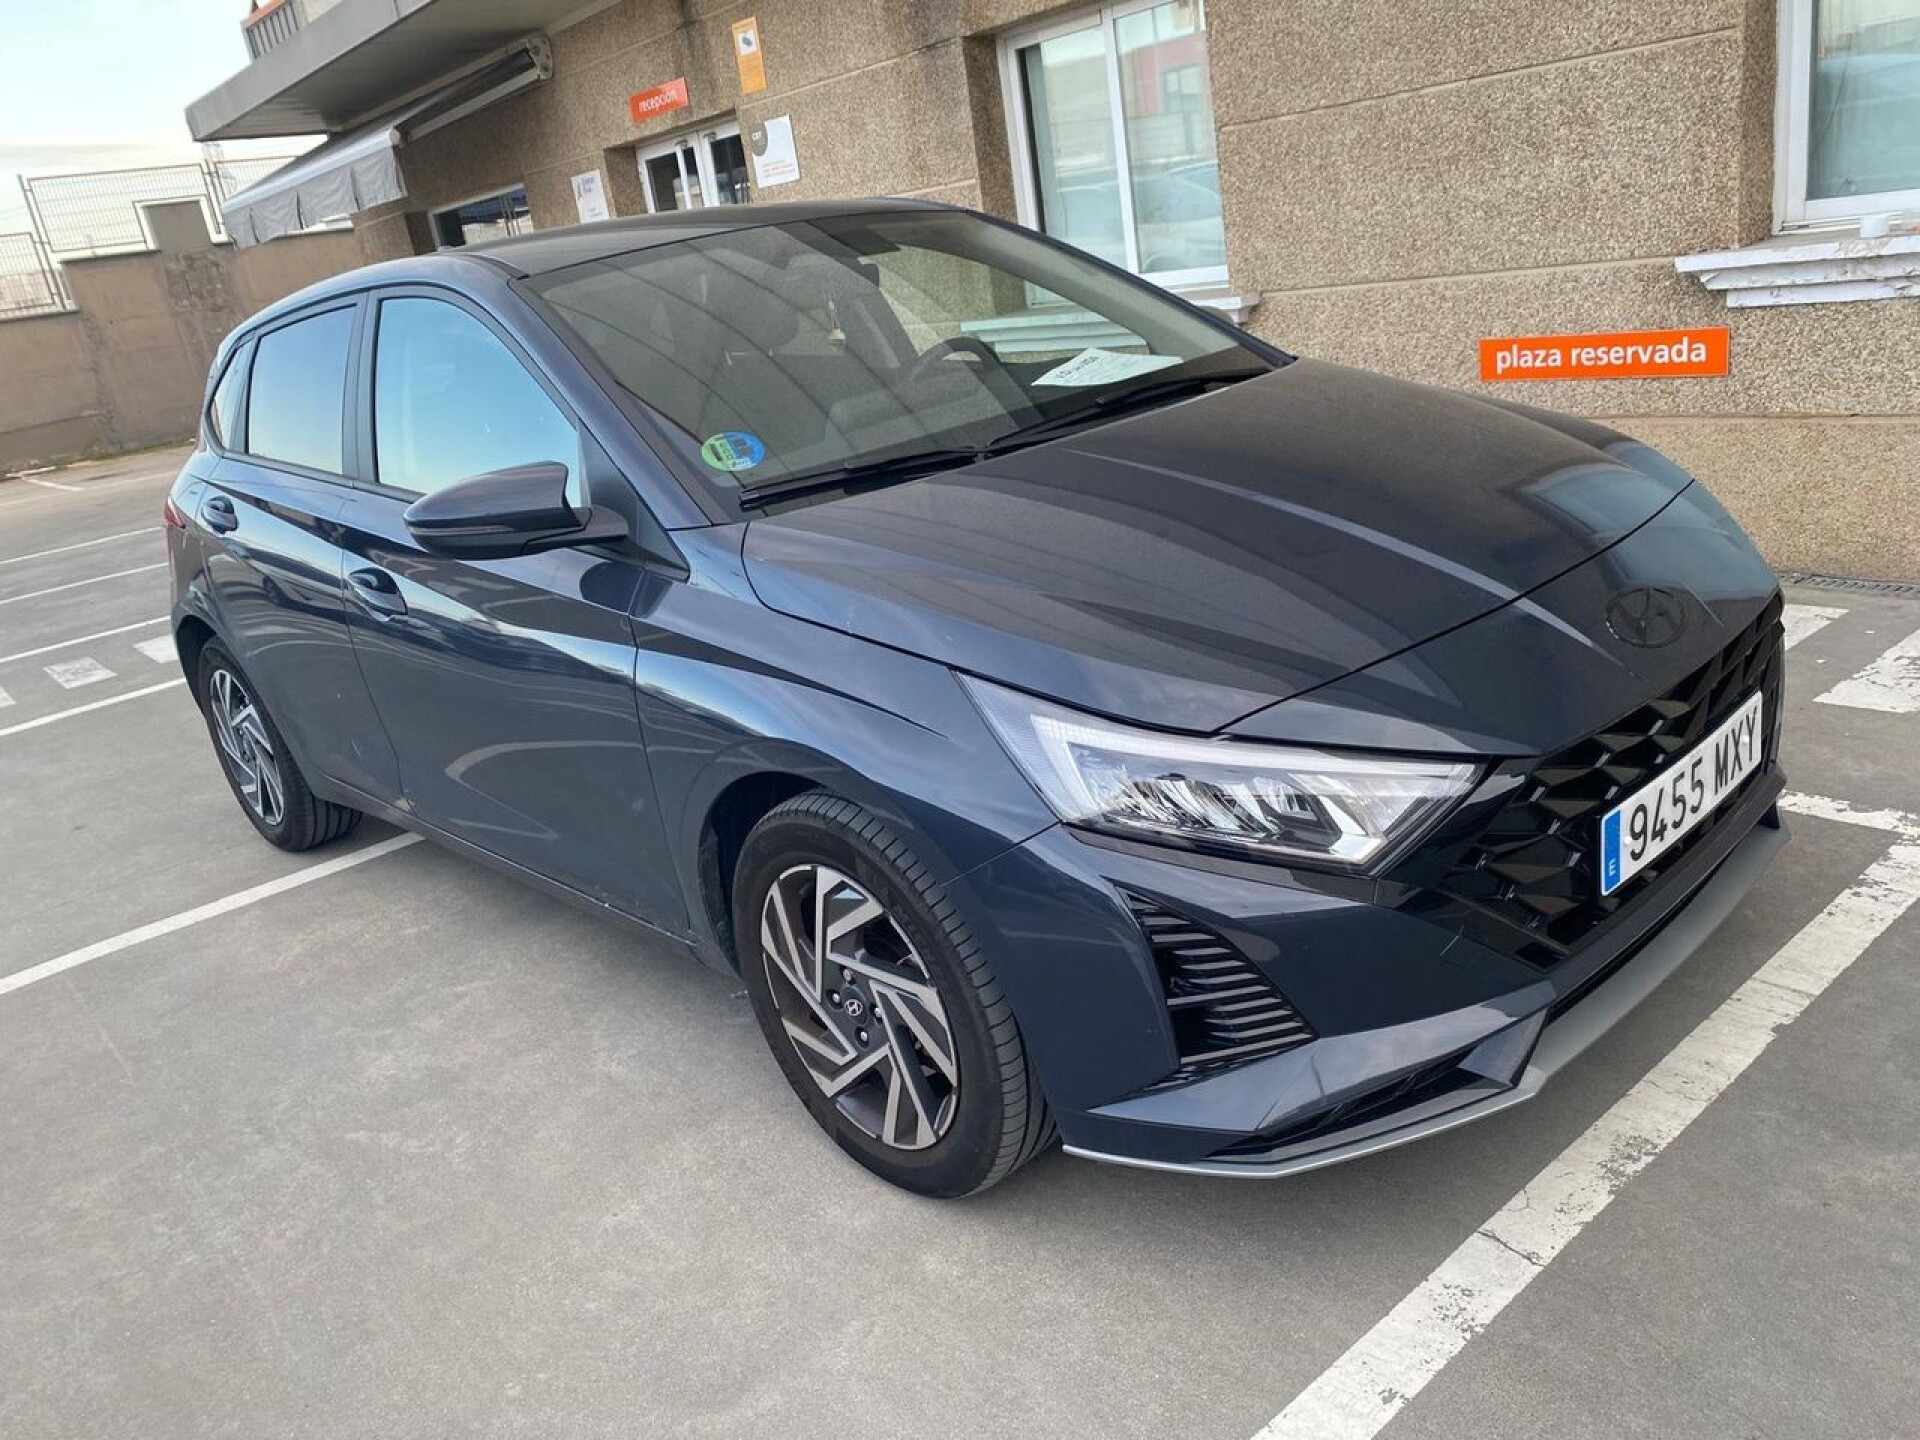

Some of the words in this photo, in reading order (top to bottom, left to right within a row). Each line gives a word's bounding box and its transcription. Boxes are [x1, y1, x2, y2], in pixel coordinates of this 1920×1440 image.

[1496, 344, 1561, 375] plaza
[1571, 336, 1706, 366] reservada
[1629, 756, 1705, 861] 9455
[1714, 706, 1758, 795] MXY
[1608, 857, 1617, 876] E
